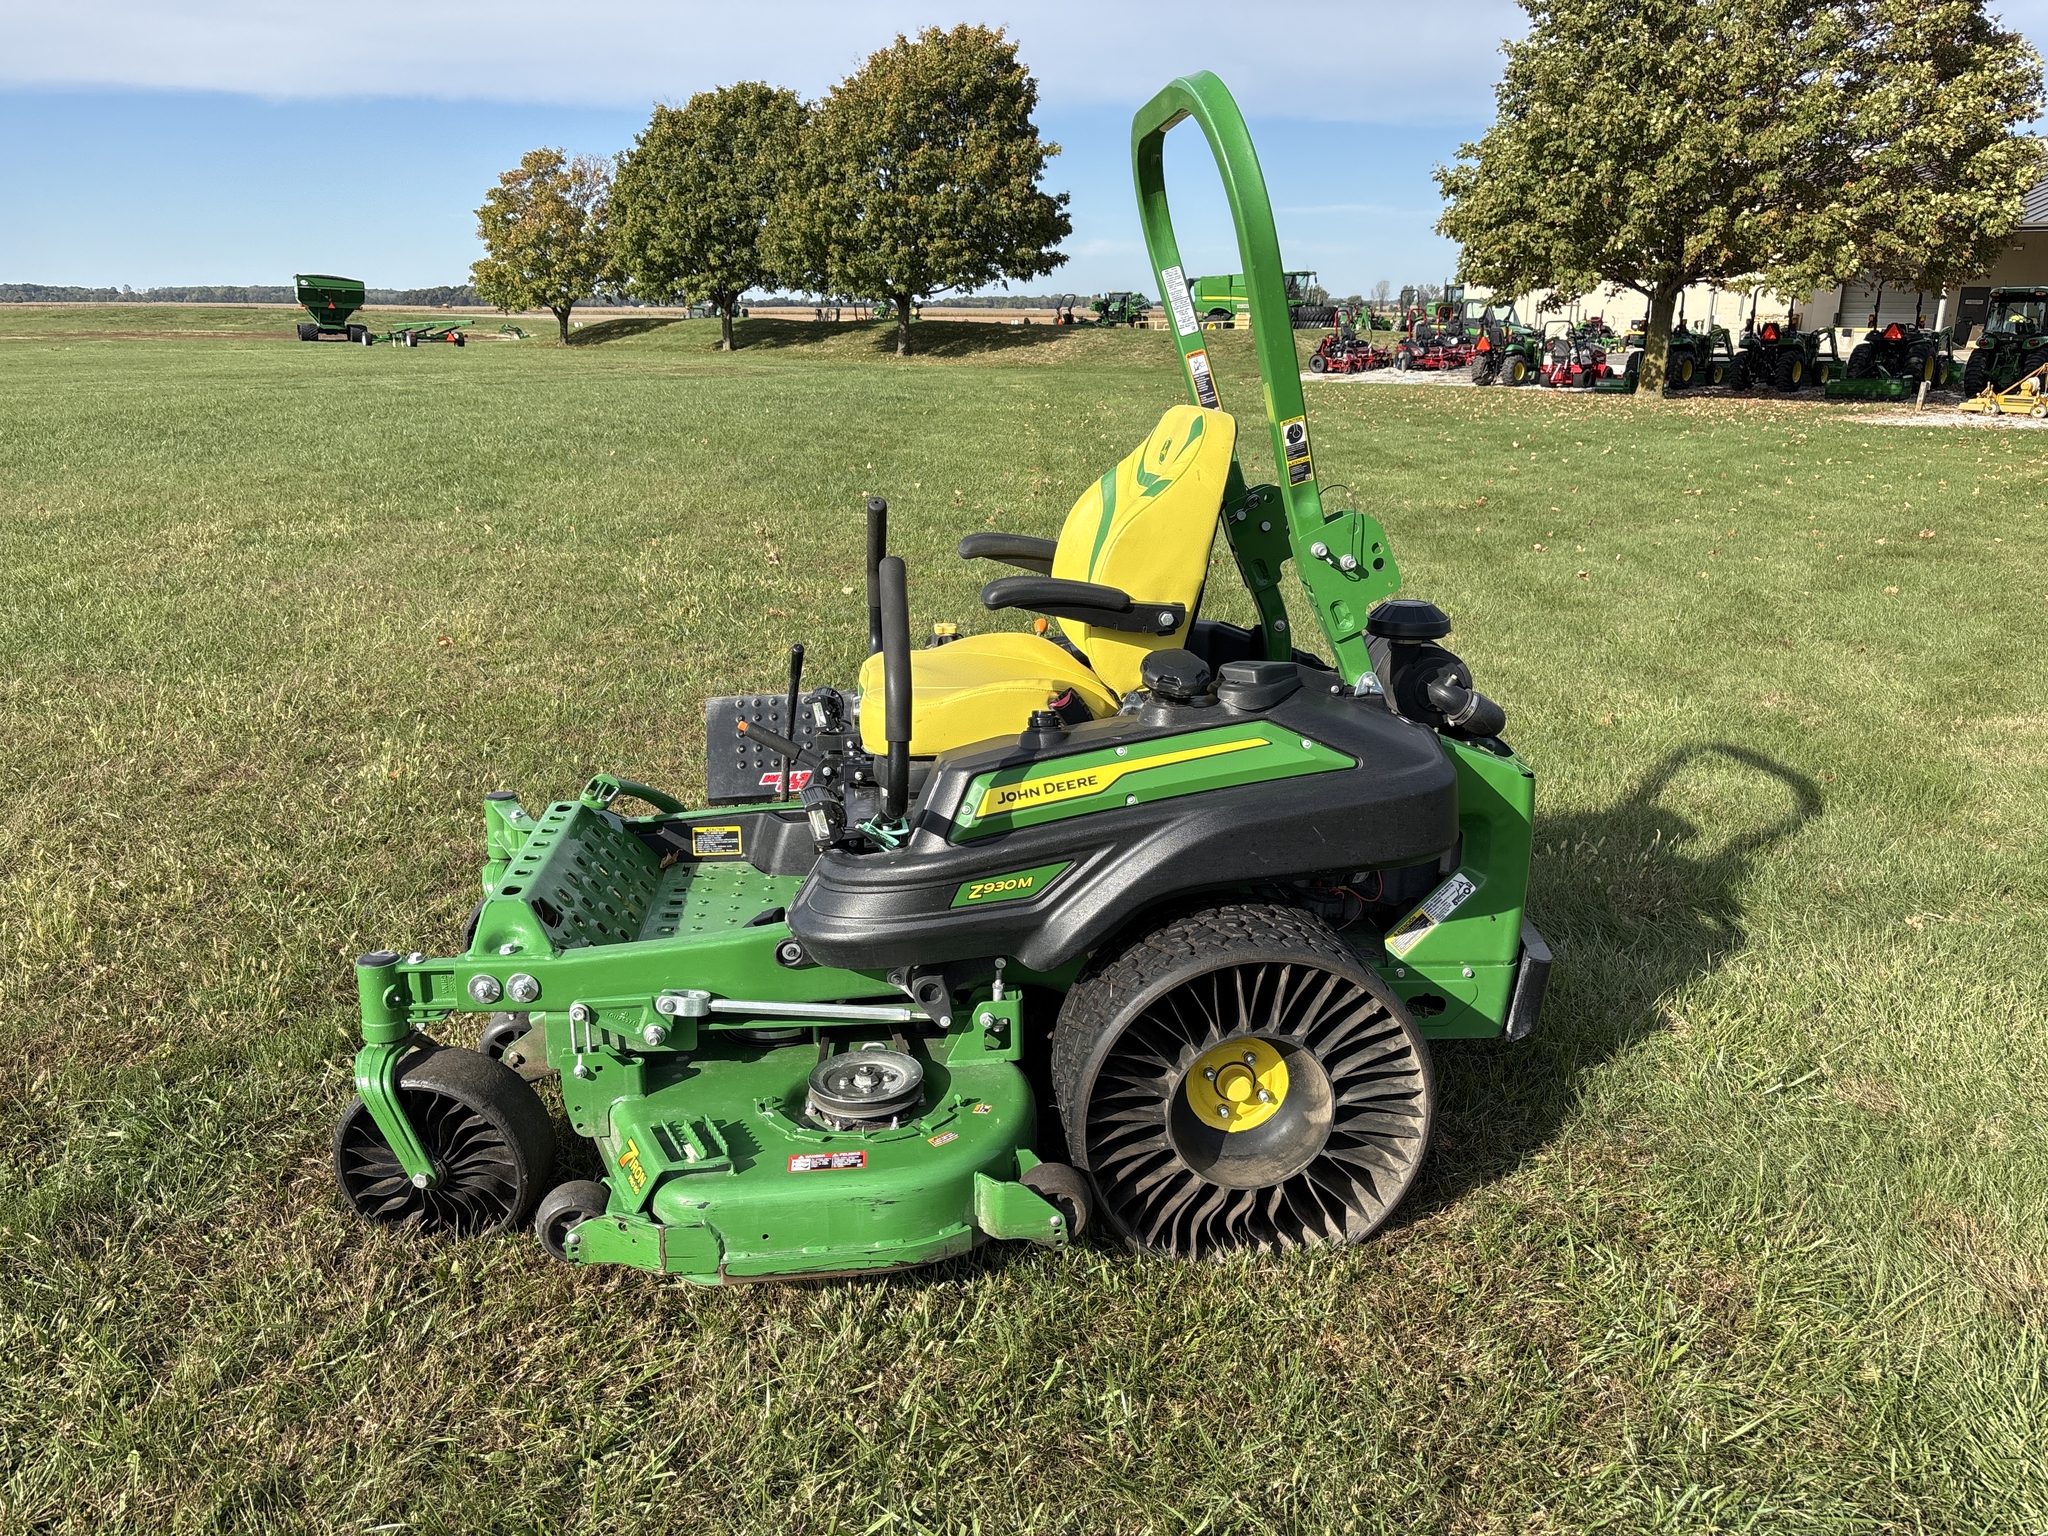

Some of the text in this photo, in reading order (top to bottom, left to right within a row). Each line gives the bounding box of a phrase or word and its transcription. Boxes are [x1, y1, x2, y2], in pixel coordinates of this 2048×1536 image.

[997, 775, 1098, 805] JOHN DEERE
[967, 876, 1034, 900] Z930M
